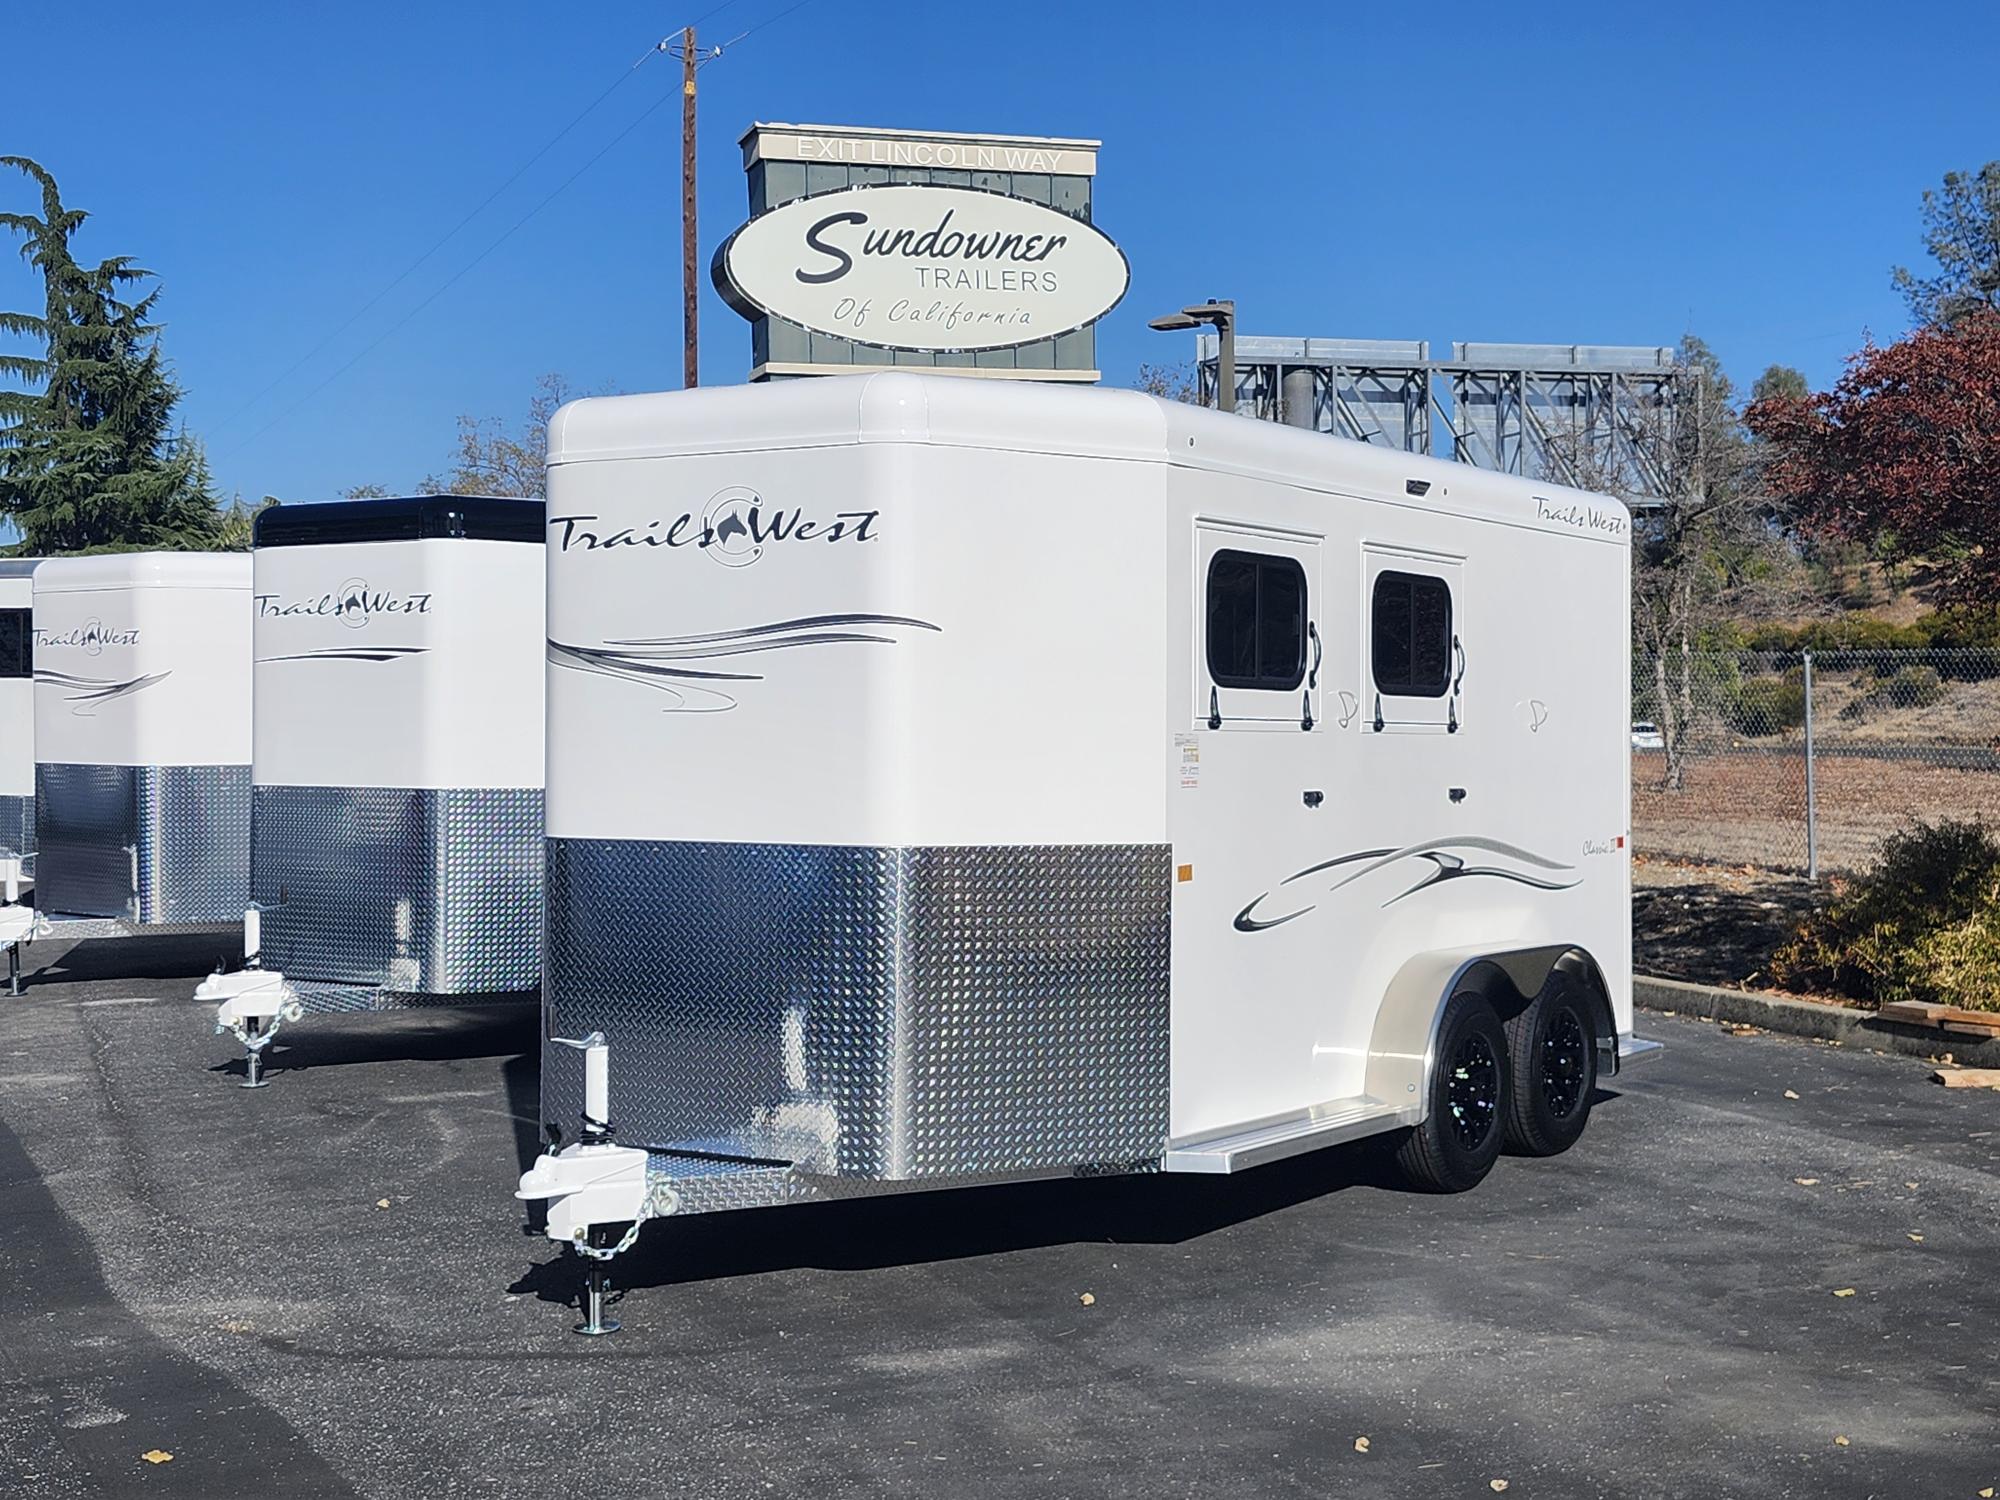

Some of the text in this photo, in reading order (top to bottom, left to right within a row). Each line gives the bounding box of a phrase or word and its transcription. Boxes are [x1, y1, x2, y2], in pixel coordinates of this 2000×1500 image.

[797, 136, 1063, 171] EXIT LINCOLN WAY
[796, 208, 1067, 284] Sundowner
[914, 267, 1057, 292] TRAILERS
[834, 297, 1030, 330] Of California
[549, 506, 879, 552] Trails West
[1532, 496, 1622, 534] Trails West
[254, 590, 431, 617] Trails West
[32, 626, 139, 647] Trails West
